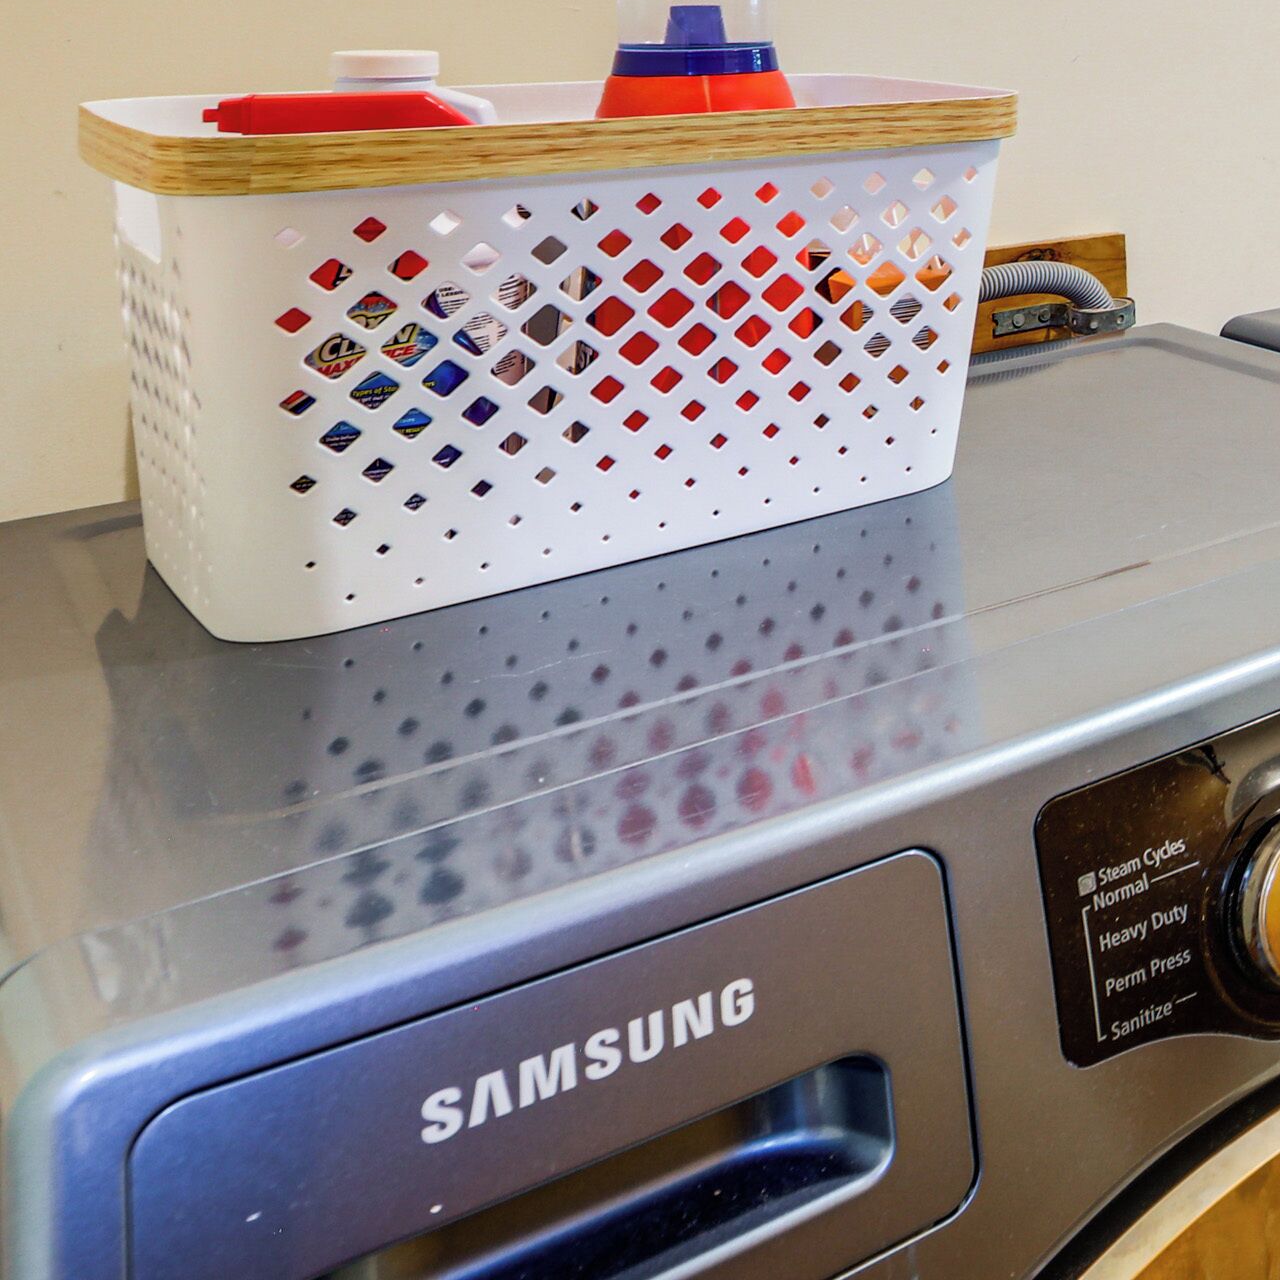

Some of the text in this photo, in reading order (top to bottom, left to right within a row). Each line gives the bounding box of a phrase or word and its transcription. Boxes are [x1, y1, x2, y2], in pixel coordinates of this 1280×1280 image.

[1098, 836, 1186, 886] Steam Cycles
[1093, 875, 1150, 912] Normal
[1099, 904, 1189, 953] Heavy Duty
[1105, 948, 1192, 998] Perm Press
[1111, 1000, 1173, 1041] Sanitize
[420, 978, 755, 1145] SAMSUNG
